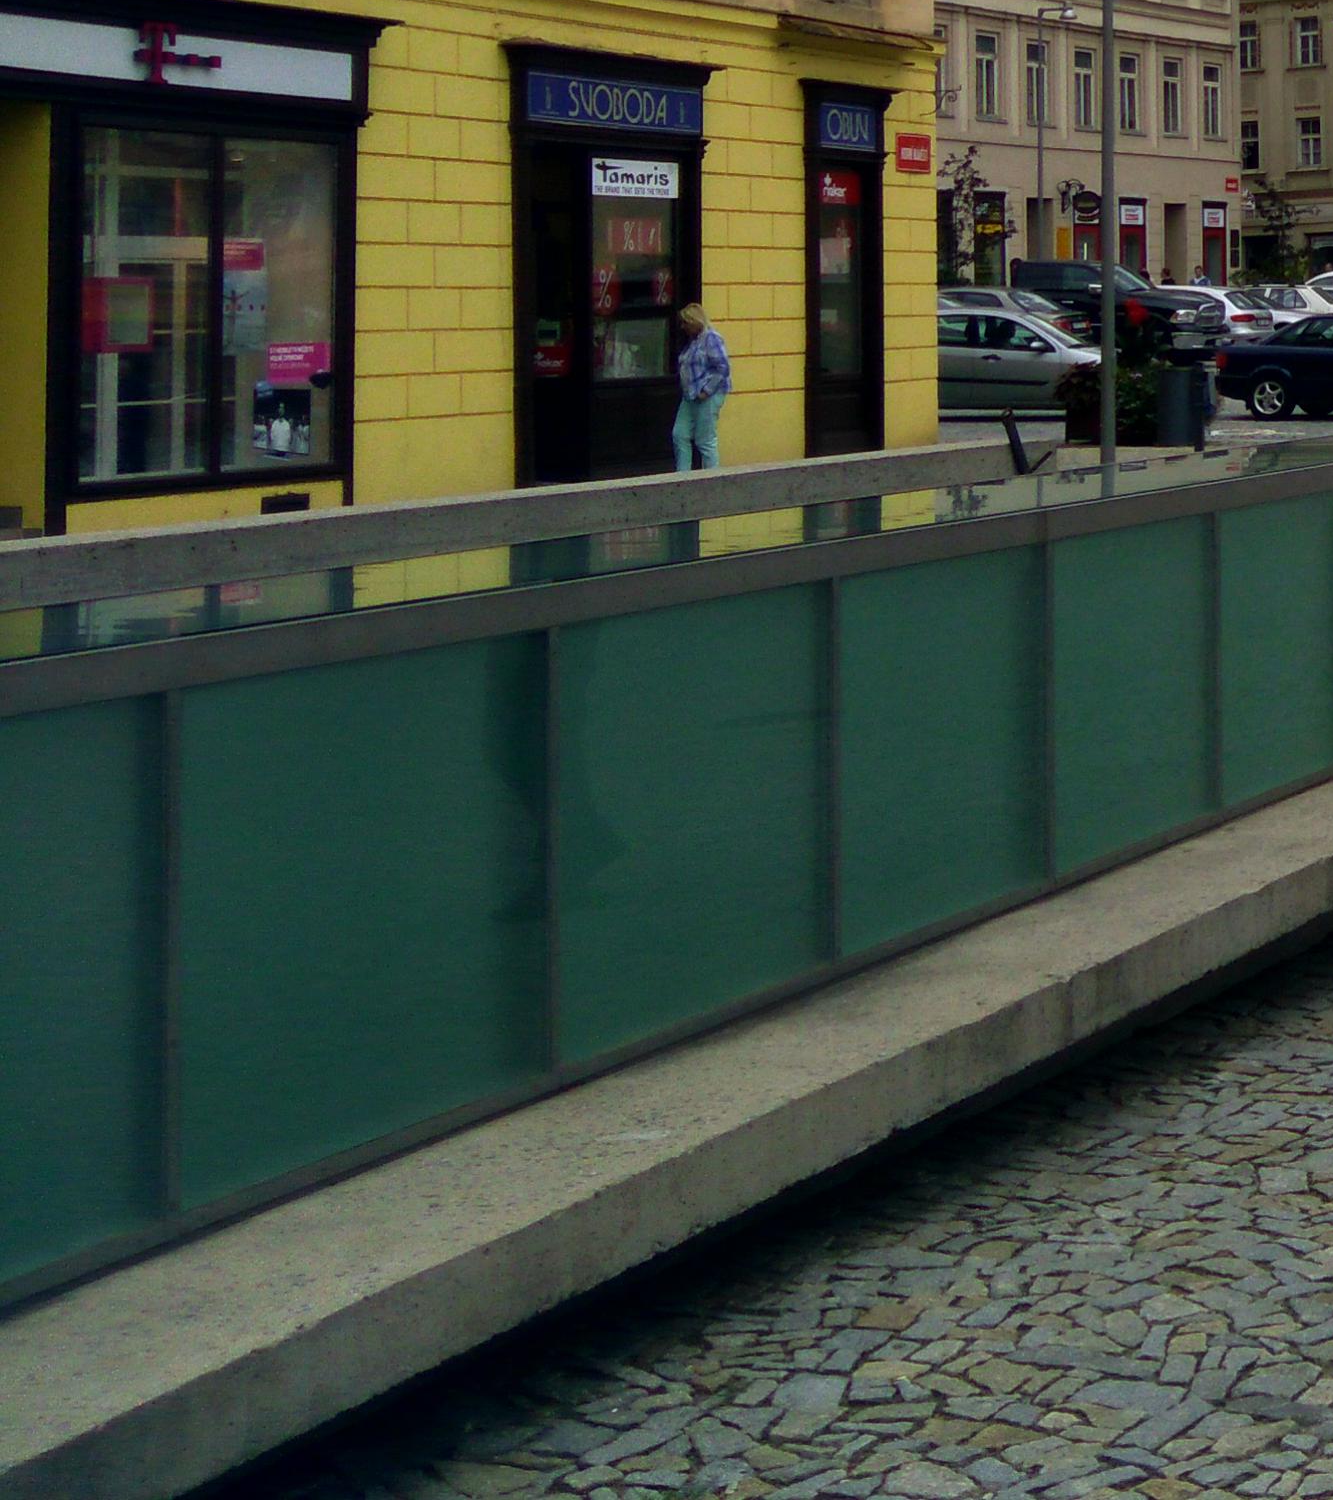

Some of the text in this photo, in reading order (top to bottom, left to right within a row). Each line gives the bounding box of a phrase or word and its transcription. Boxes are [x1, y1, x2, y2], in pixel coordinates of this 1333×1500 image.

[568, 80, 667, 125] SVOBODA
[827, 108, 869, 142] OBUV
[594, 160, 670, 186] Tamaris
